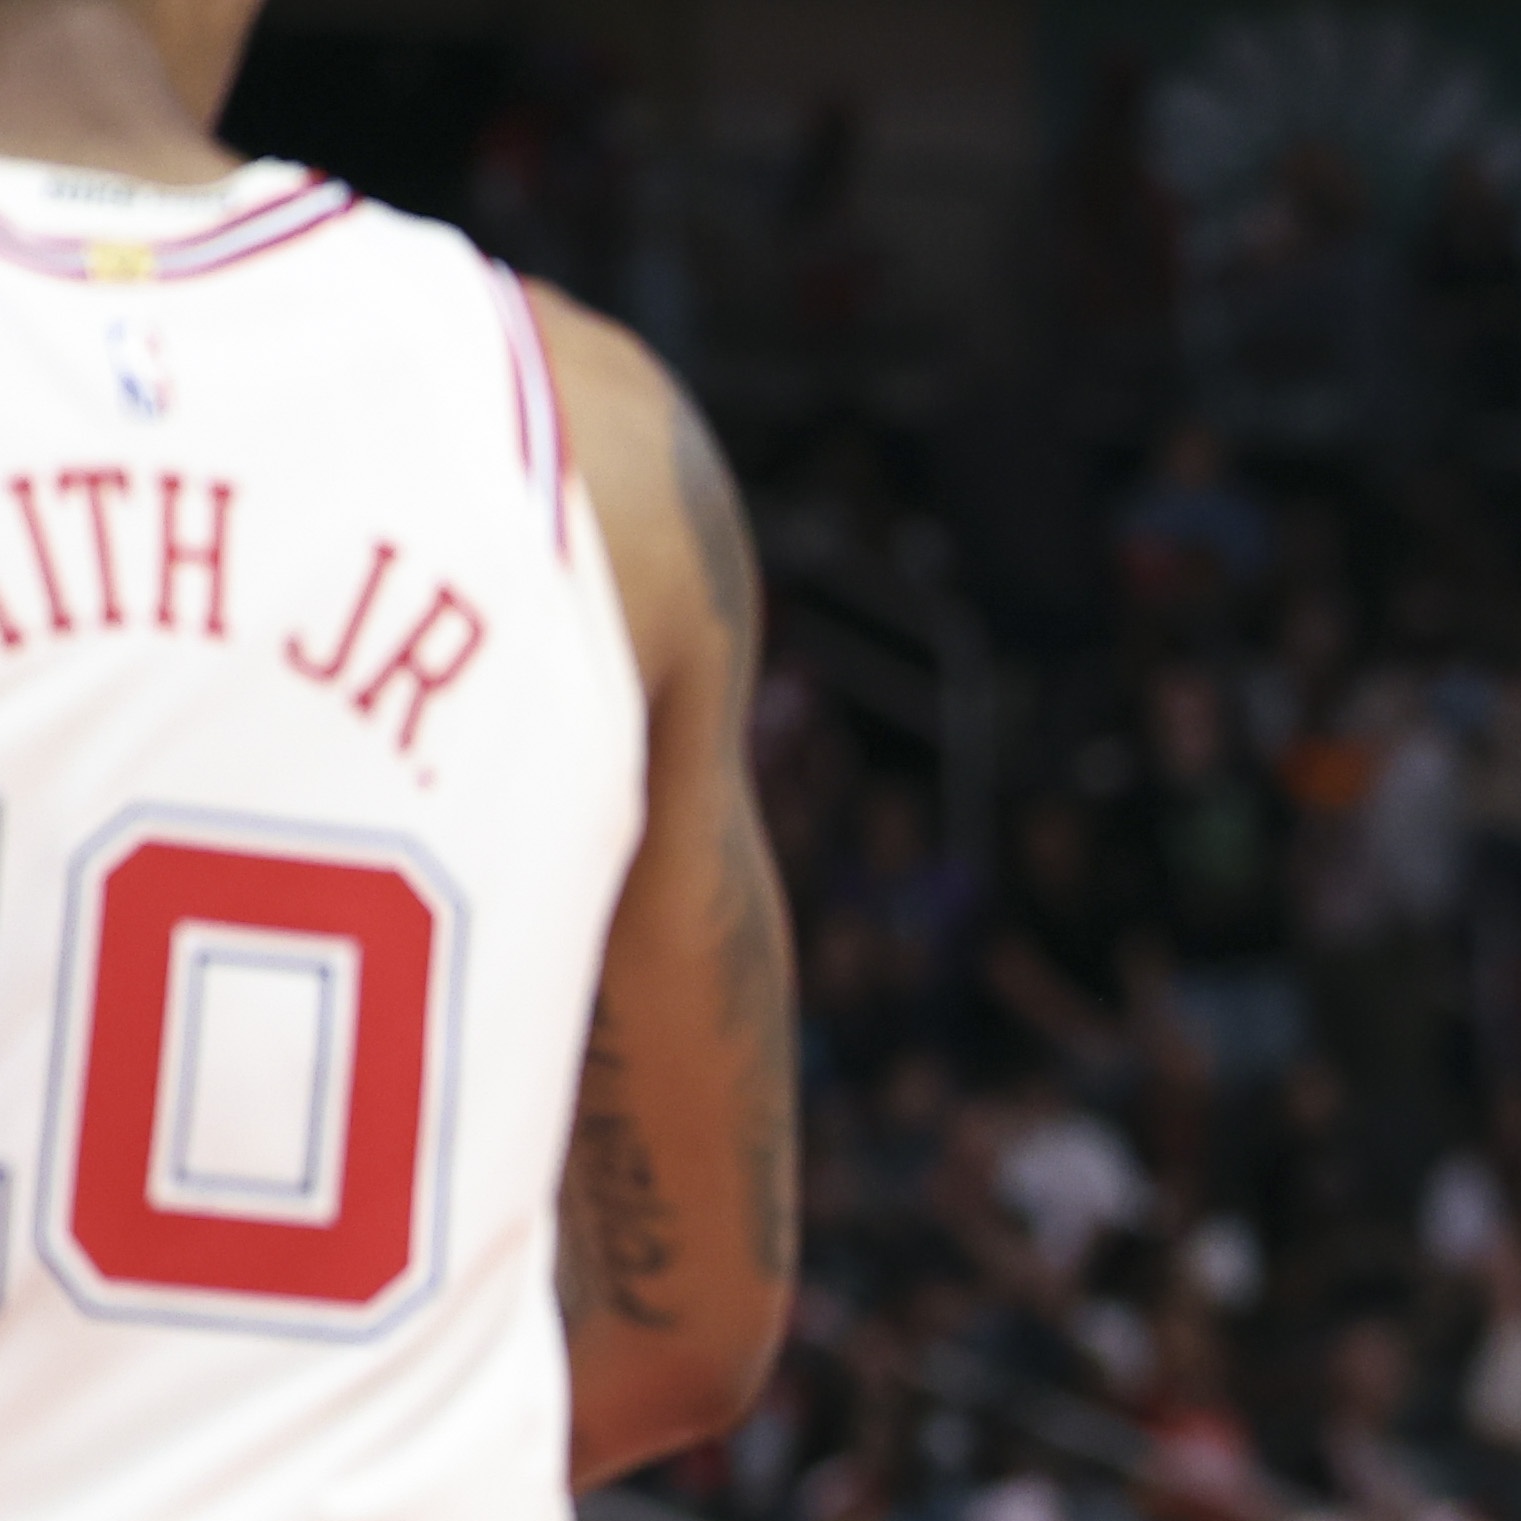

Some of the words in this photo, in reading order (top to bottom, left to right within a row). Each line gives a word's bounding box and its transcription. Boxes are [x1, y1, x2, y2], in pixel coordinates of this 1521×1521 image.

[0, 466, 235, 650] ITH
[284, 542, 489, 788] JR.
[0, 800, 471, 1344] 0
